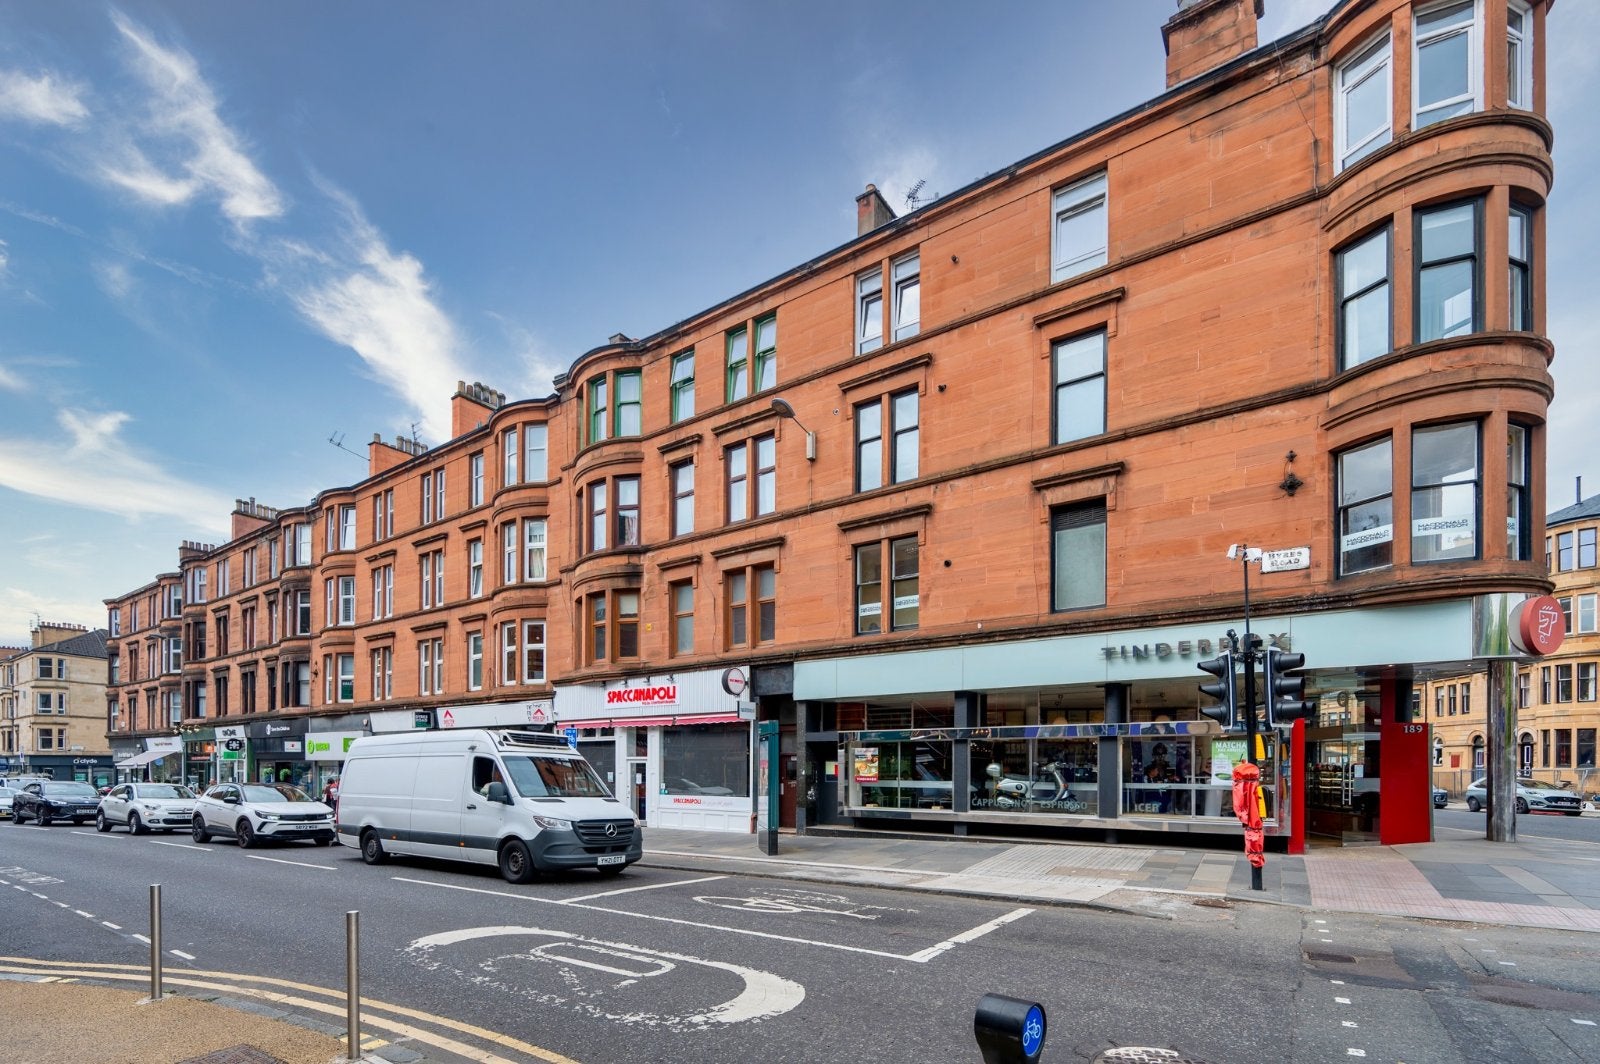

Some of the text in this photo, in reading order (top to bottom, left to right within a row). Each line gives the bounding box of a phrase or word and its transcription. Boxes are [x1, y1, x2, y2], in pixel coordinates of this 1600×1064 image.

[1268, 551, 1302, 559] BYRES
[1270, 558, 1300, 567] ROAD
[607, 685, 676, 704] SPACCANAPOLI
[1403, 725, 1423, 733] 189
[1215, 741, 1247, 749] MATCHA
